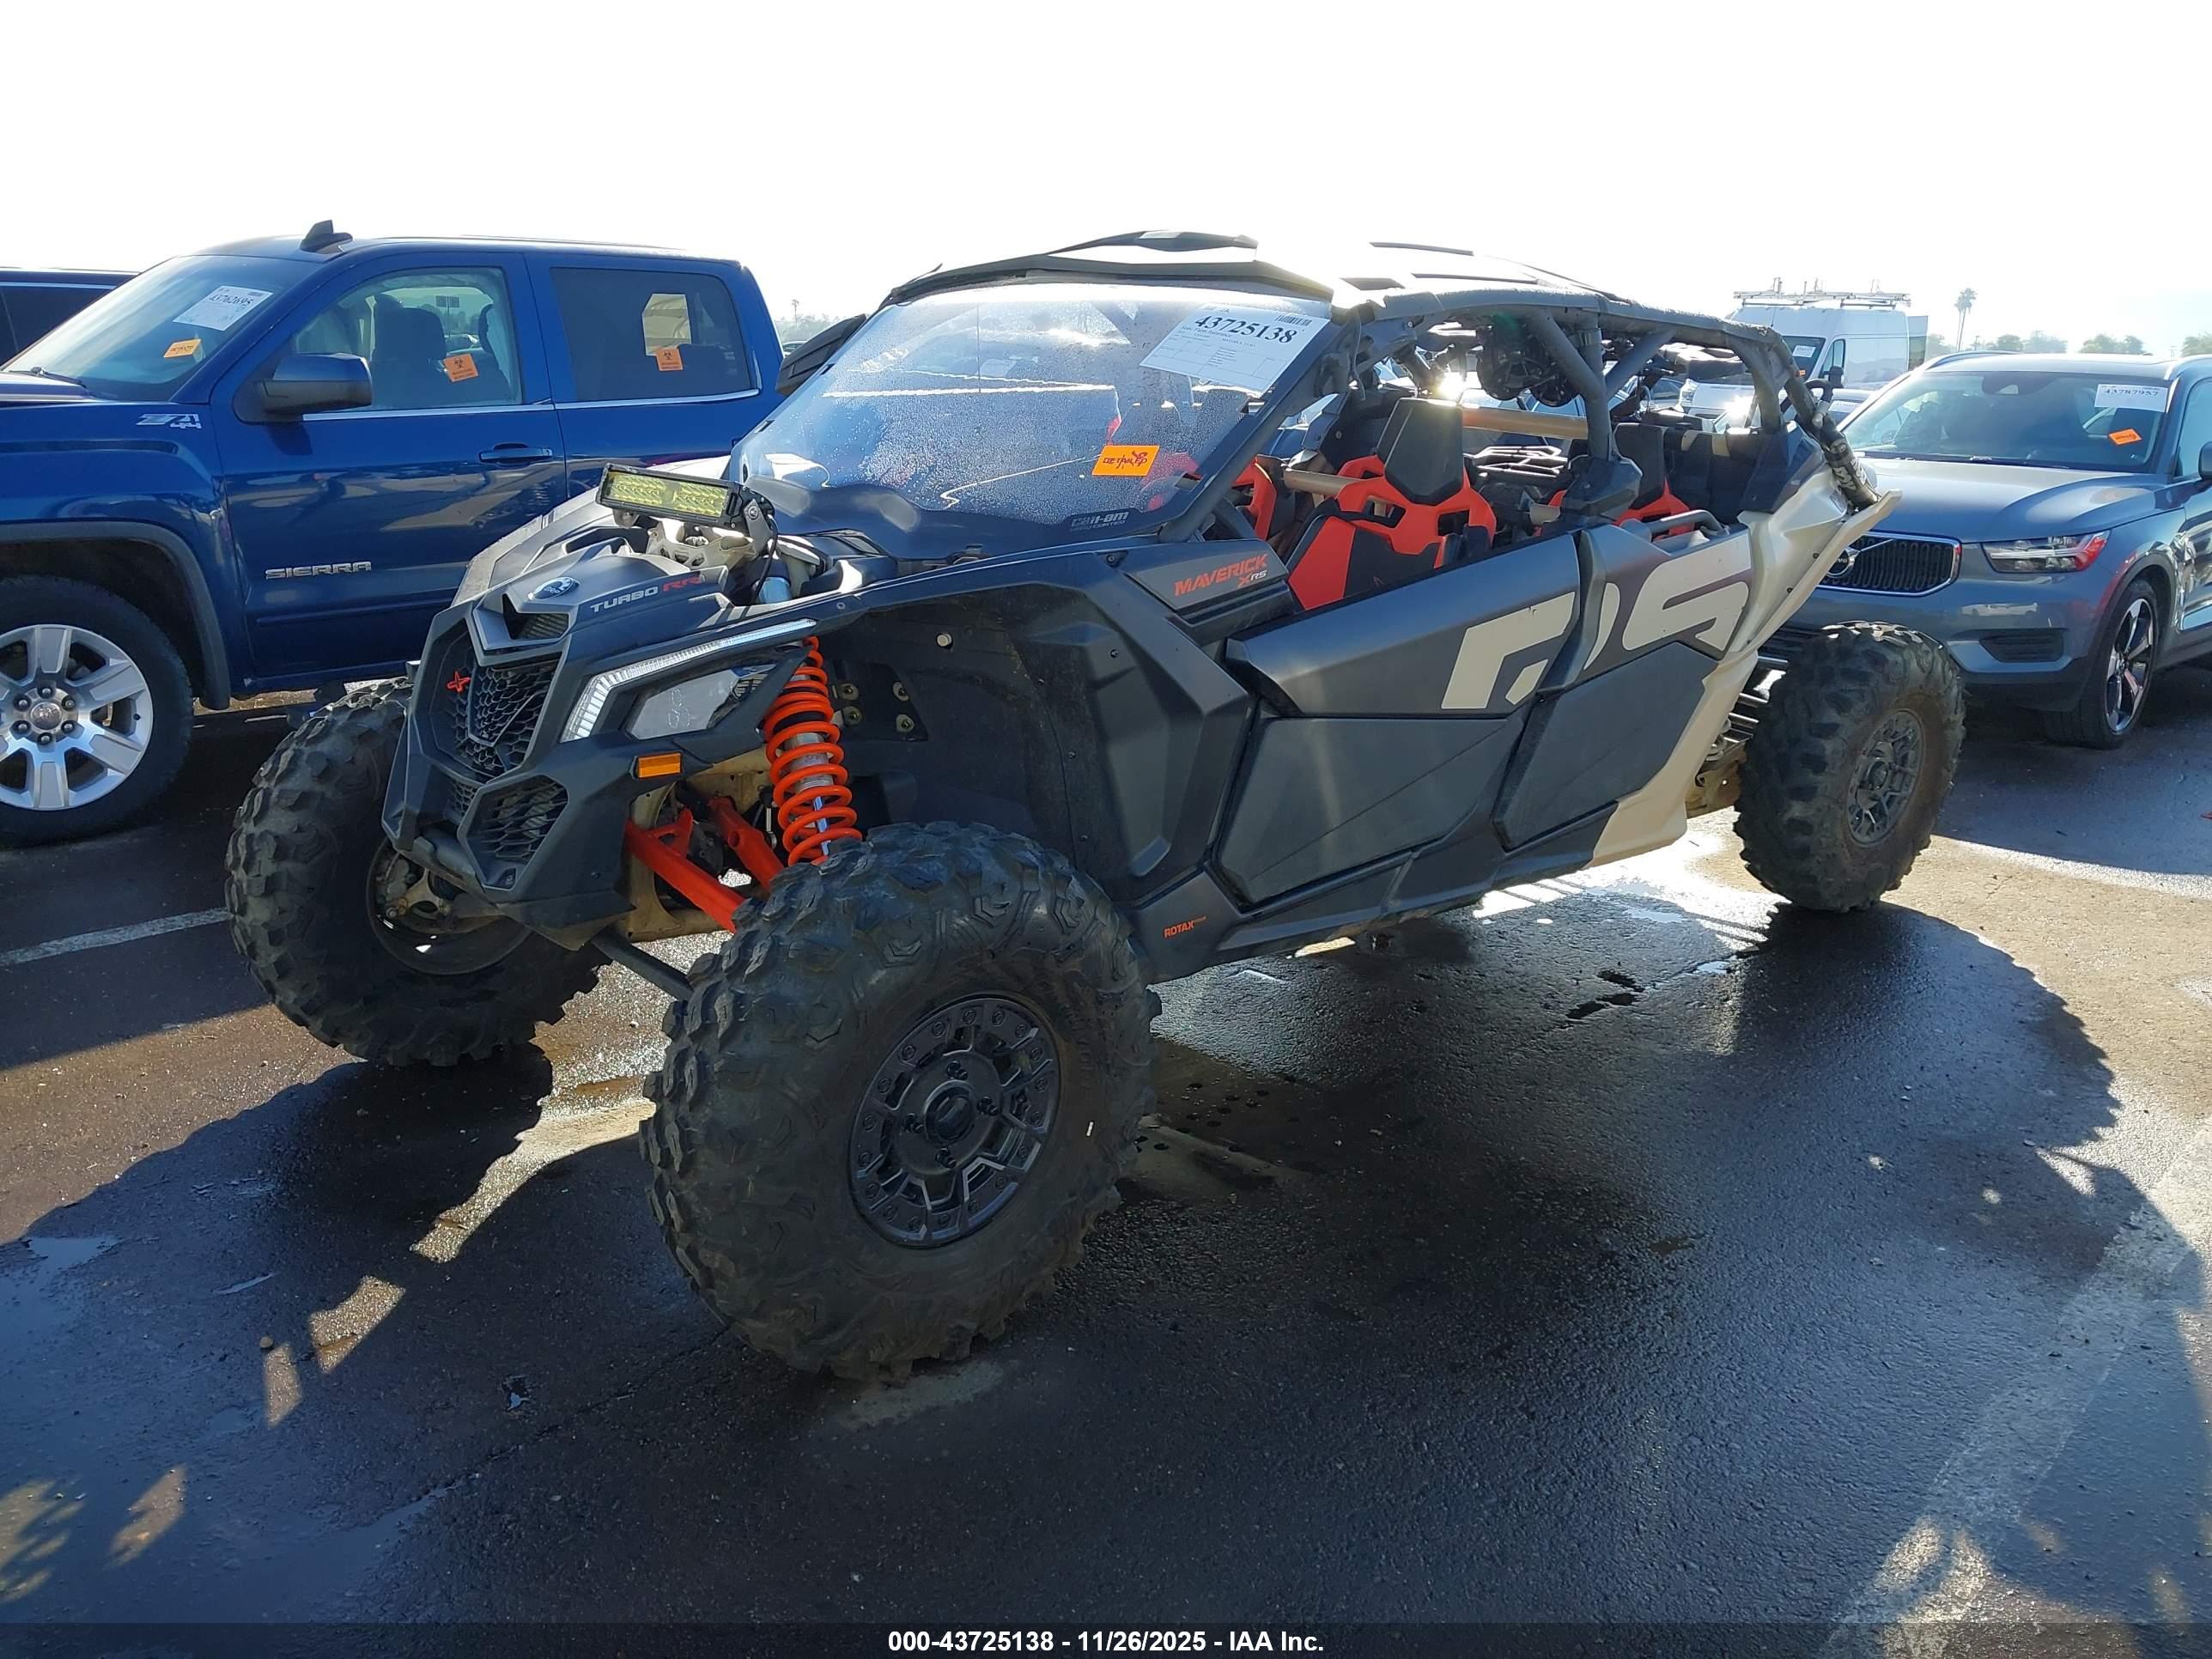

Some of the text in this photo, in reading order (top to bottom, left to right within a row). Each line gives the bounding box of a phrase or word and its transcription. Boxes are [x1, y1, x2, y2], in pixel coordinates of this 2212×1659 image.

[1194, 315, 1297, 343] 43725138
[265, 561, 372, 580] SIERRA
[1174, 553, 1268, 597] MAVERICK
[590, 576, 702, 613] TURBO RR
[1164, 920, 1194, 939] ROTAX
